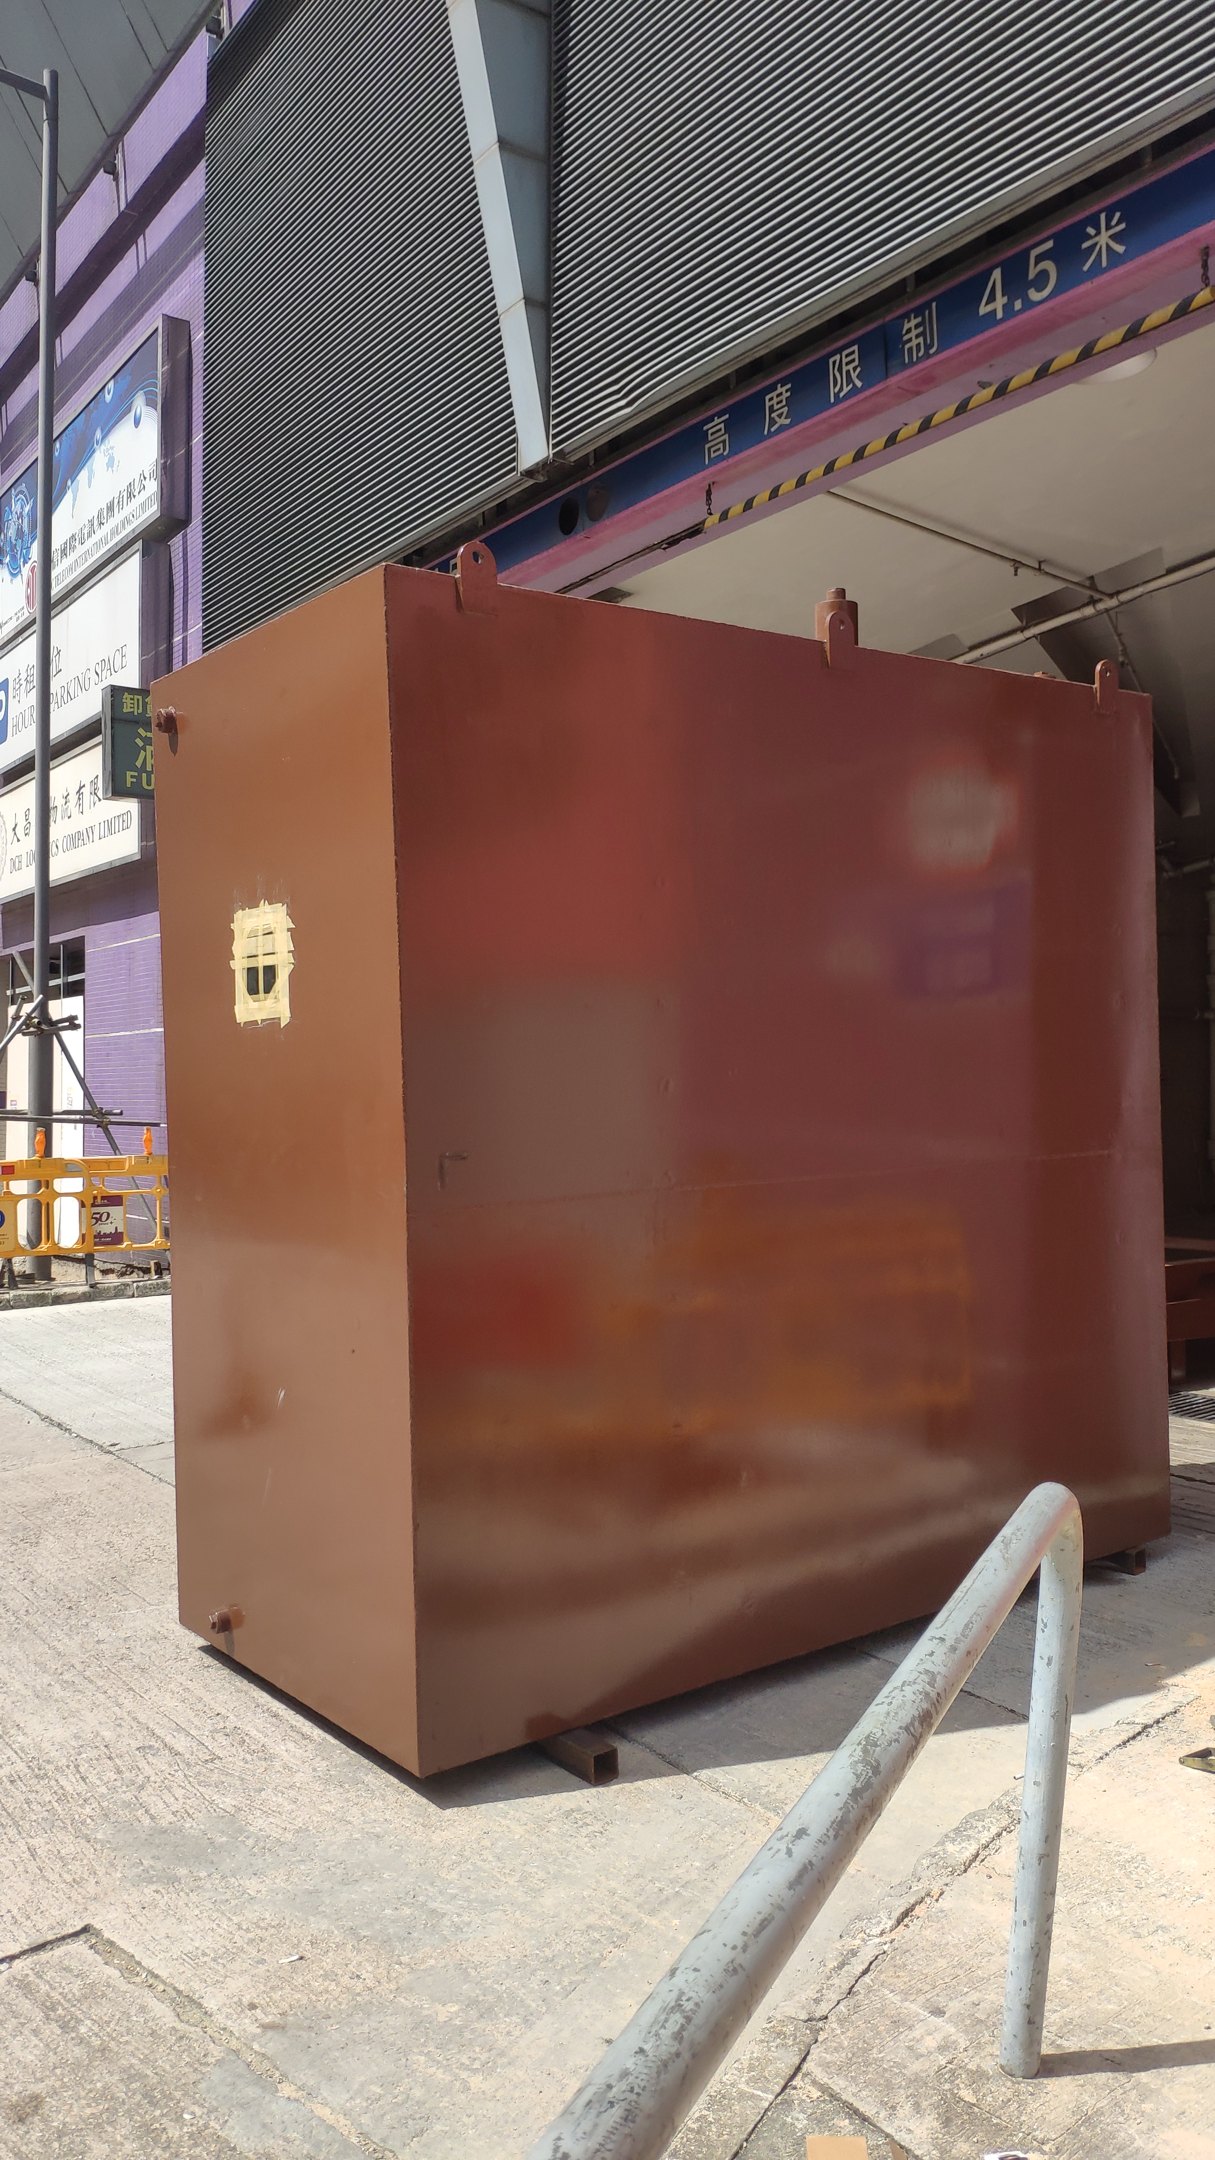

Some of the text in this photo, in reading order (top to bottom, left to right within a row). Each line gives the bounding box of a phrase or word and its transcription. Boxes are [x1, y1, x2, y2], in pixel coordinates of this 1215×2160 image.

[702, 211, 1126, 465] 高度限制 4.5 米
[136, 490, 158, 521] LIMITED
[11, 704, 36, 738] HOUR
[50, 667, 91, 714] PARKING
[94, 644, 128, 686] SPACE
[12, 645, 62, 704] 時租位
[126, 770, 155, 790] FU
[9, 853, 23, 874] DCH
[62, 824, 97, 853] COMPANY
[98, 809, 133, 841] LIMITED
